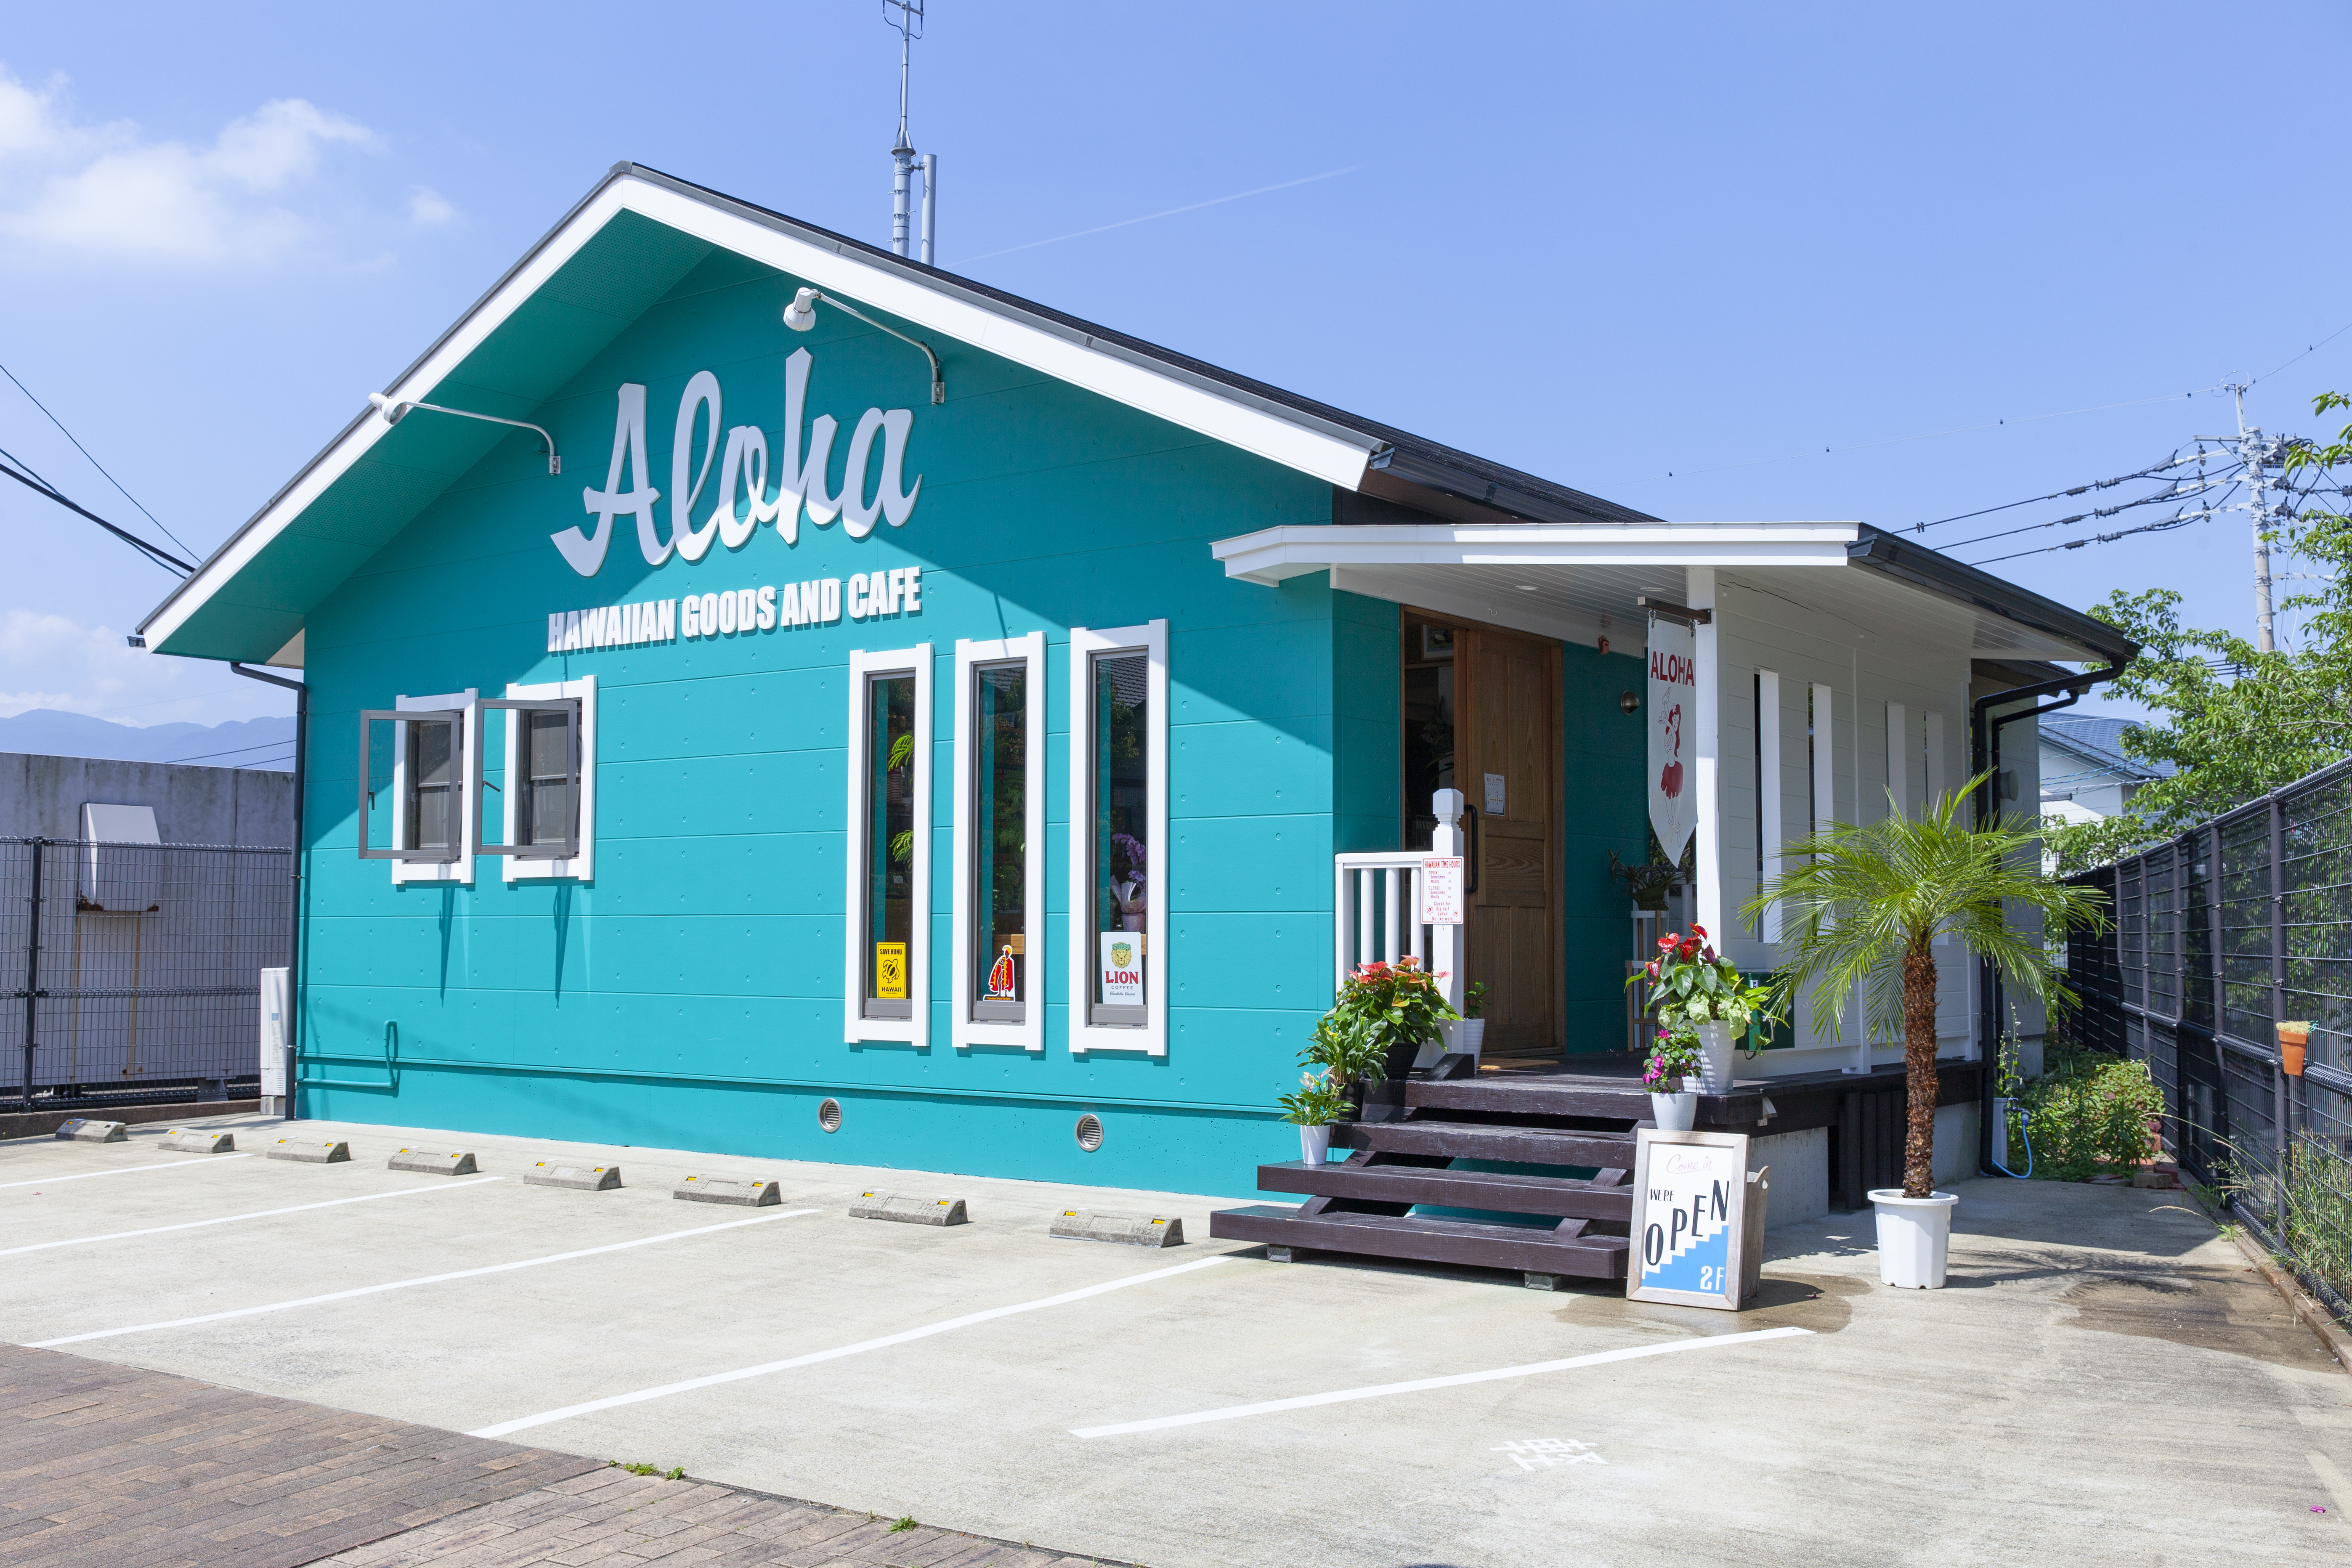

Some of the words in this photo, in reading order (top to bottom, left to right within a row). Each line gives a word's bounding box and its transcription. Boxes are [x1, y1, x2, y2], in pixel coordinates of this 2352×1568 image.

[550, 346, 923, 577] Aloha
[548, 599, 677, 652] HAWAIIAN
[682, 585, 777, 638] GOODS
[780, 578, 842, 627] AND
[847, 566, 922, 618] CAFE
[1650, 651, 1695, 687] ALOHA
[1105, 971, 1139, 984] LION
[1667, 1154, 1699, 1173] Come
[1703, 1156, 1712, 1171] in
[1645, 1180, 1730, 1266] OPEN
[1700, 1266, 1724, 1291] 2F
